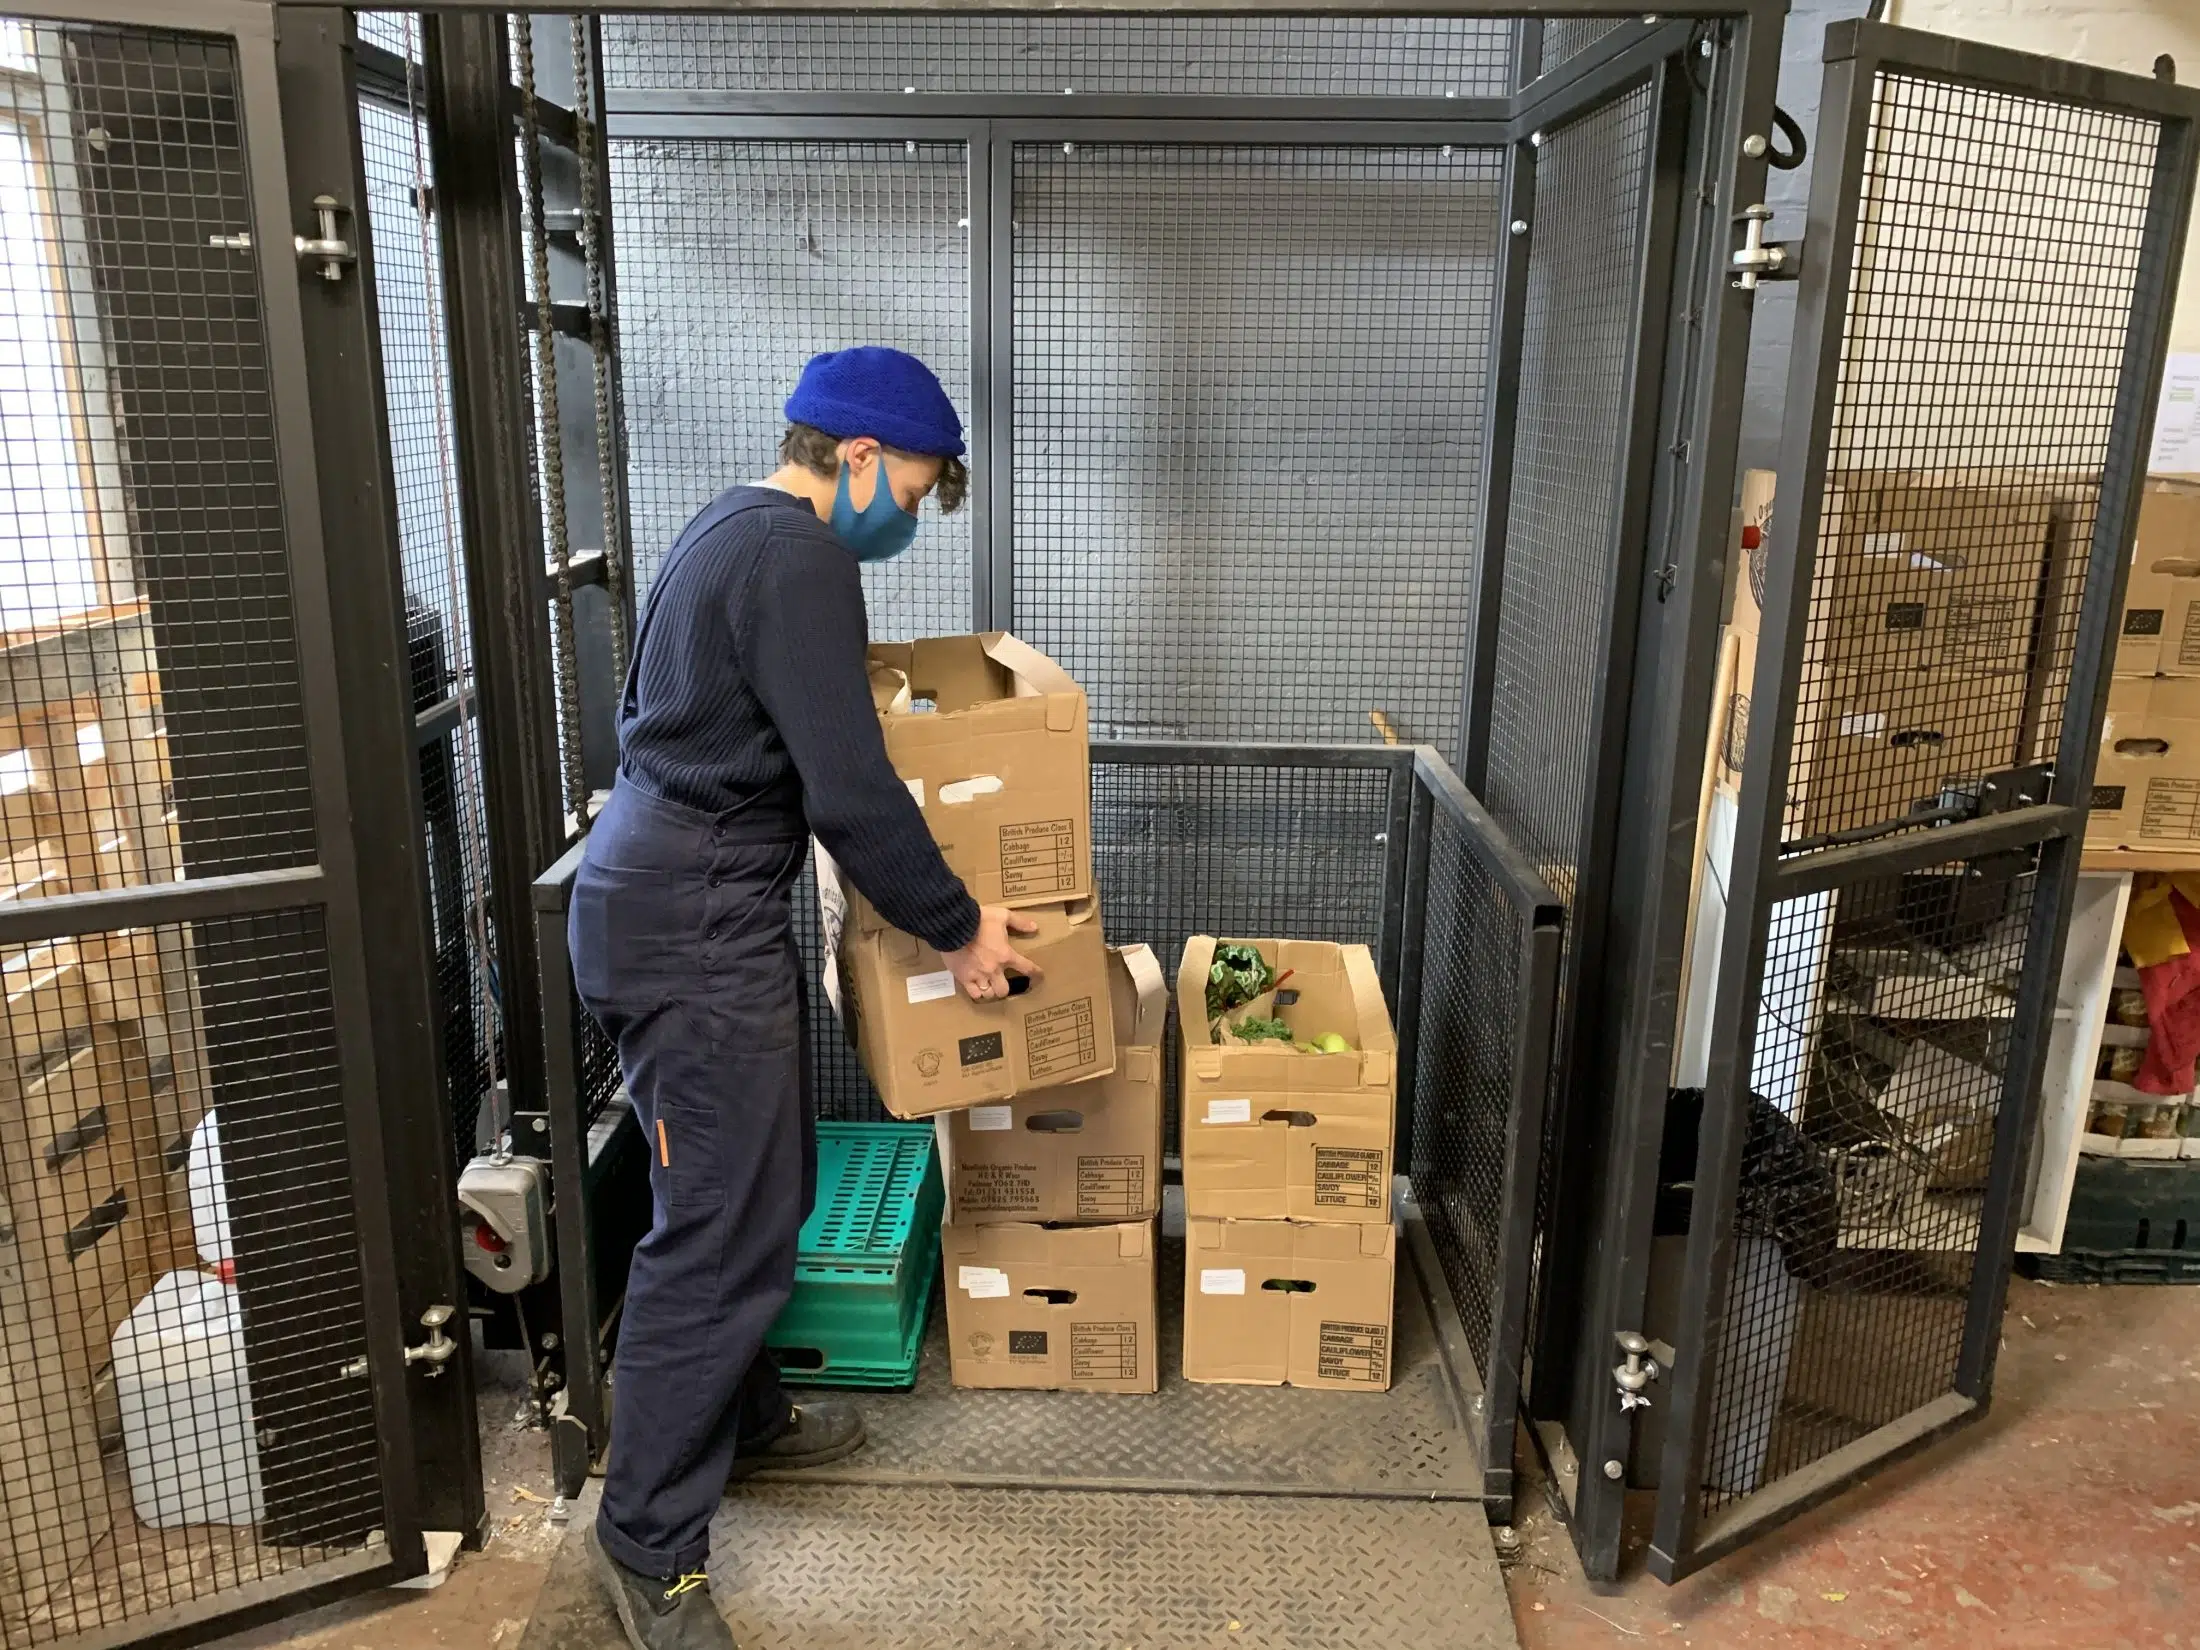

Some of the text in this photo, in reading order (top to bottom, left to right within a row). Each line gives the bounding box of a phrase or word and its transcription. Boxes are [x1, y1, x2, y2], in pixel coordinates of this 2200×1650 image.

[526, 424, 537, 466] 250
[1003, 837, 1070, 852] Cabbage 12
[1004, 871, 1023, 880] Savoy
[1005, 878, 1072, 893] Lettuce 12
[1080, 1014, 1088, 1022] 12
[1083, 1052, 1092, 1060] 12
[1316, 1196, 1347, 1204] LETTUCE
[1322, 1334, 1354, 1344] CABBAGE
[1320, 1356, 1344, 1365] SAVOY
[1320, 1368, 1350, 1377] LETTUCE
